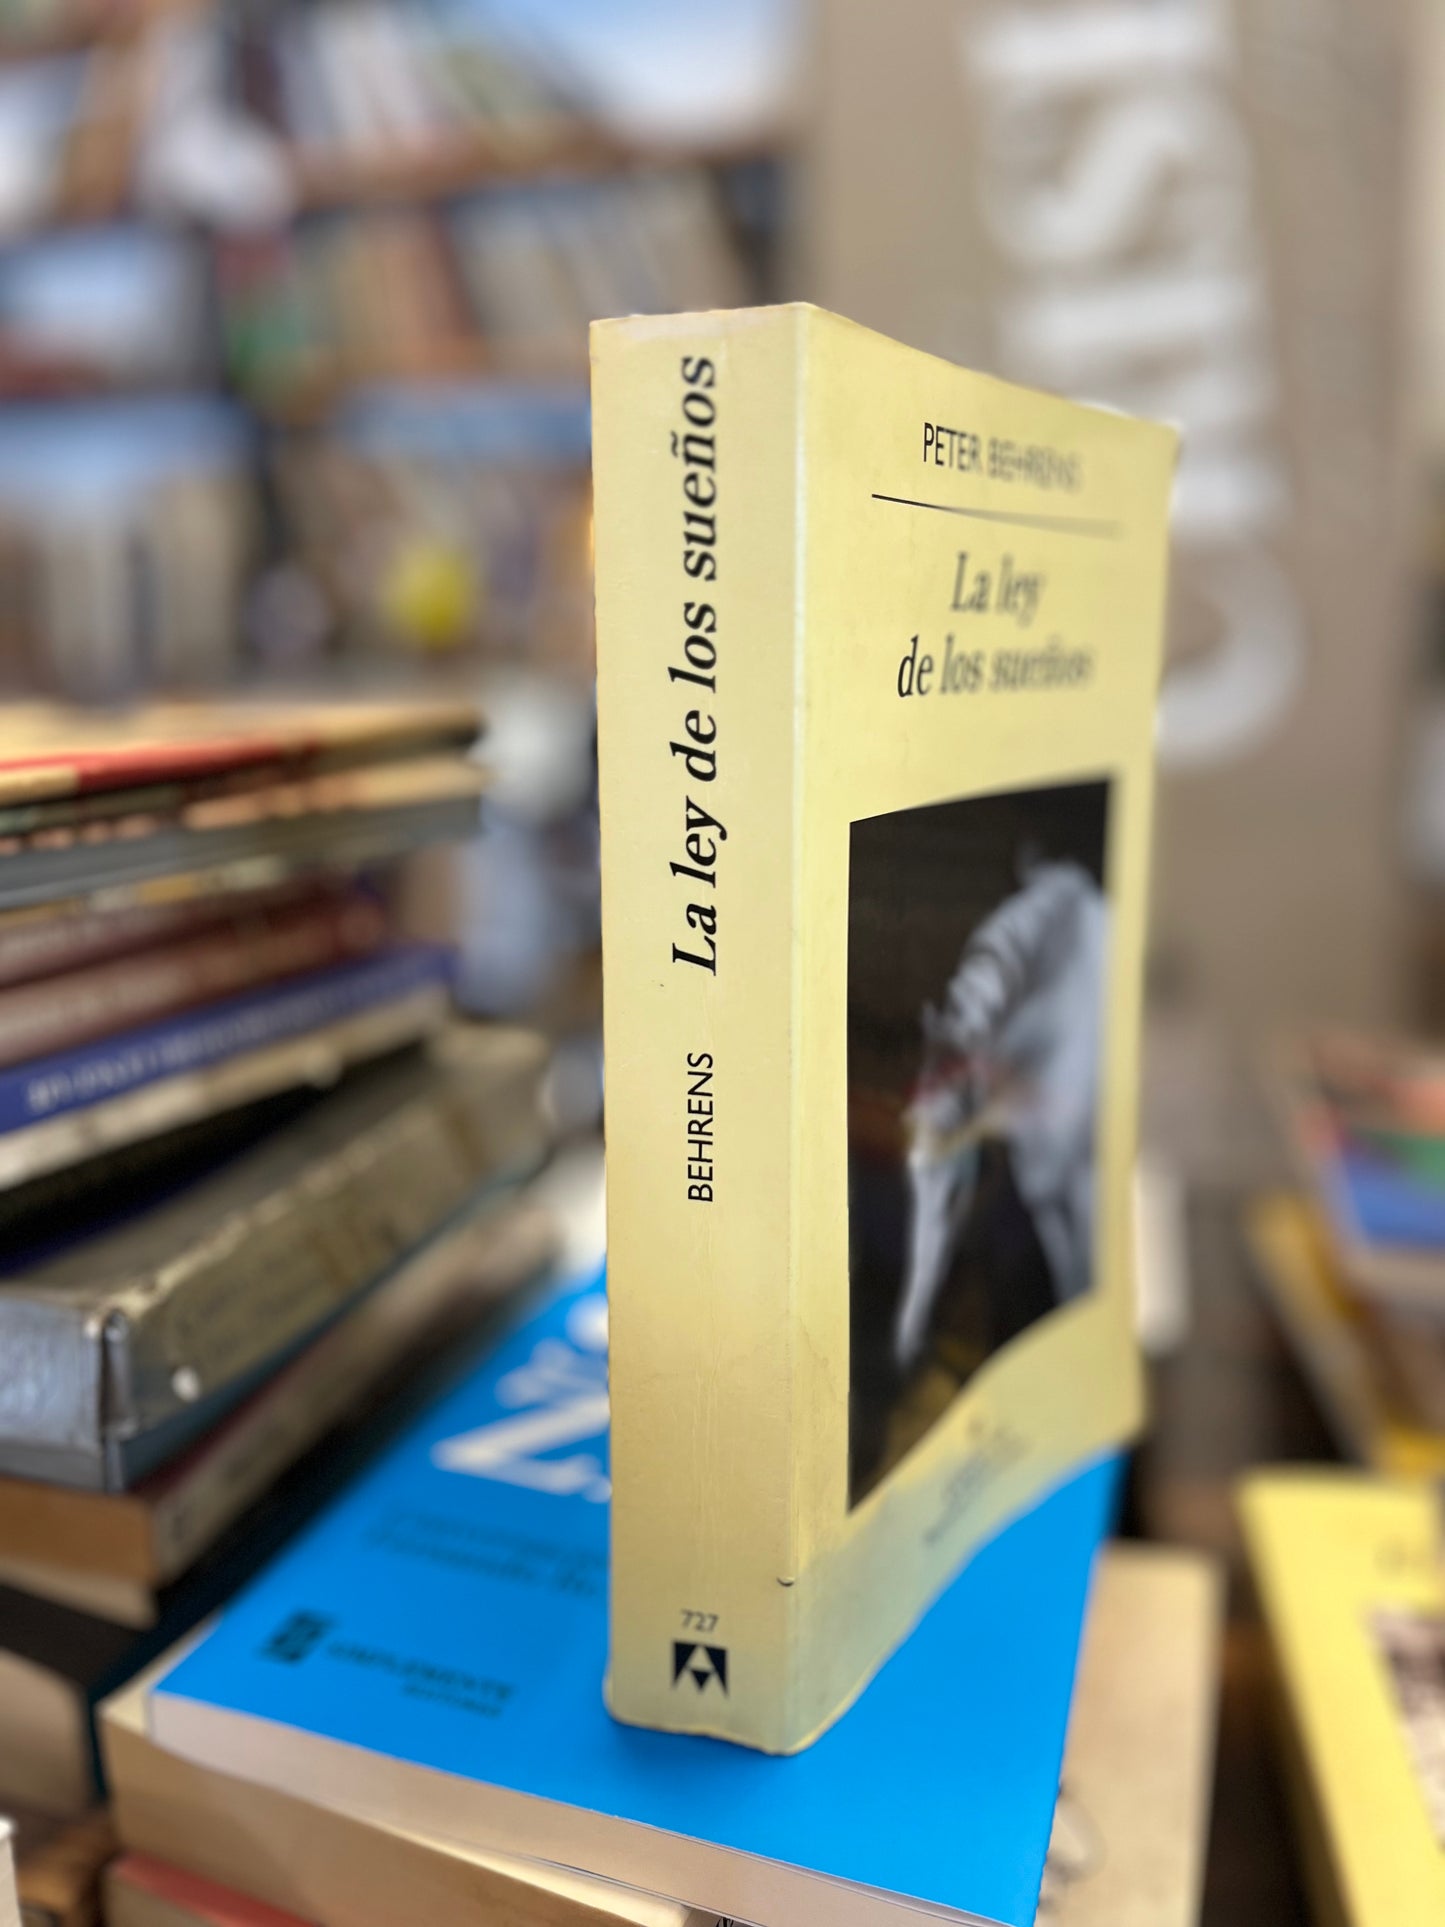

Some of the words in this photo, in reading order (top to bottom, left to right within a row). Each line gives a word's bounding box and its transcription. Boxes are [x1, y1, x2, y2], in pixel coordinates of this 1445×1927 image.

[670, 355, 718, 582] sueños
[923, 421, 983, 475] PETER
[950, 550, 991, 615] La
[667, 600, 718, 694] los
[897, 632, 934, 698] de
[938, 631, 986, 696] los
[669, 709, 718, 783] de
[668, 794, 728, 889] ley
[672, 902, 717, 977] La
[687, 1052, 714, 1203] BEHRENS
[680, 1607, 719, 1633] 727
